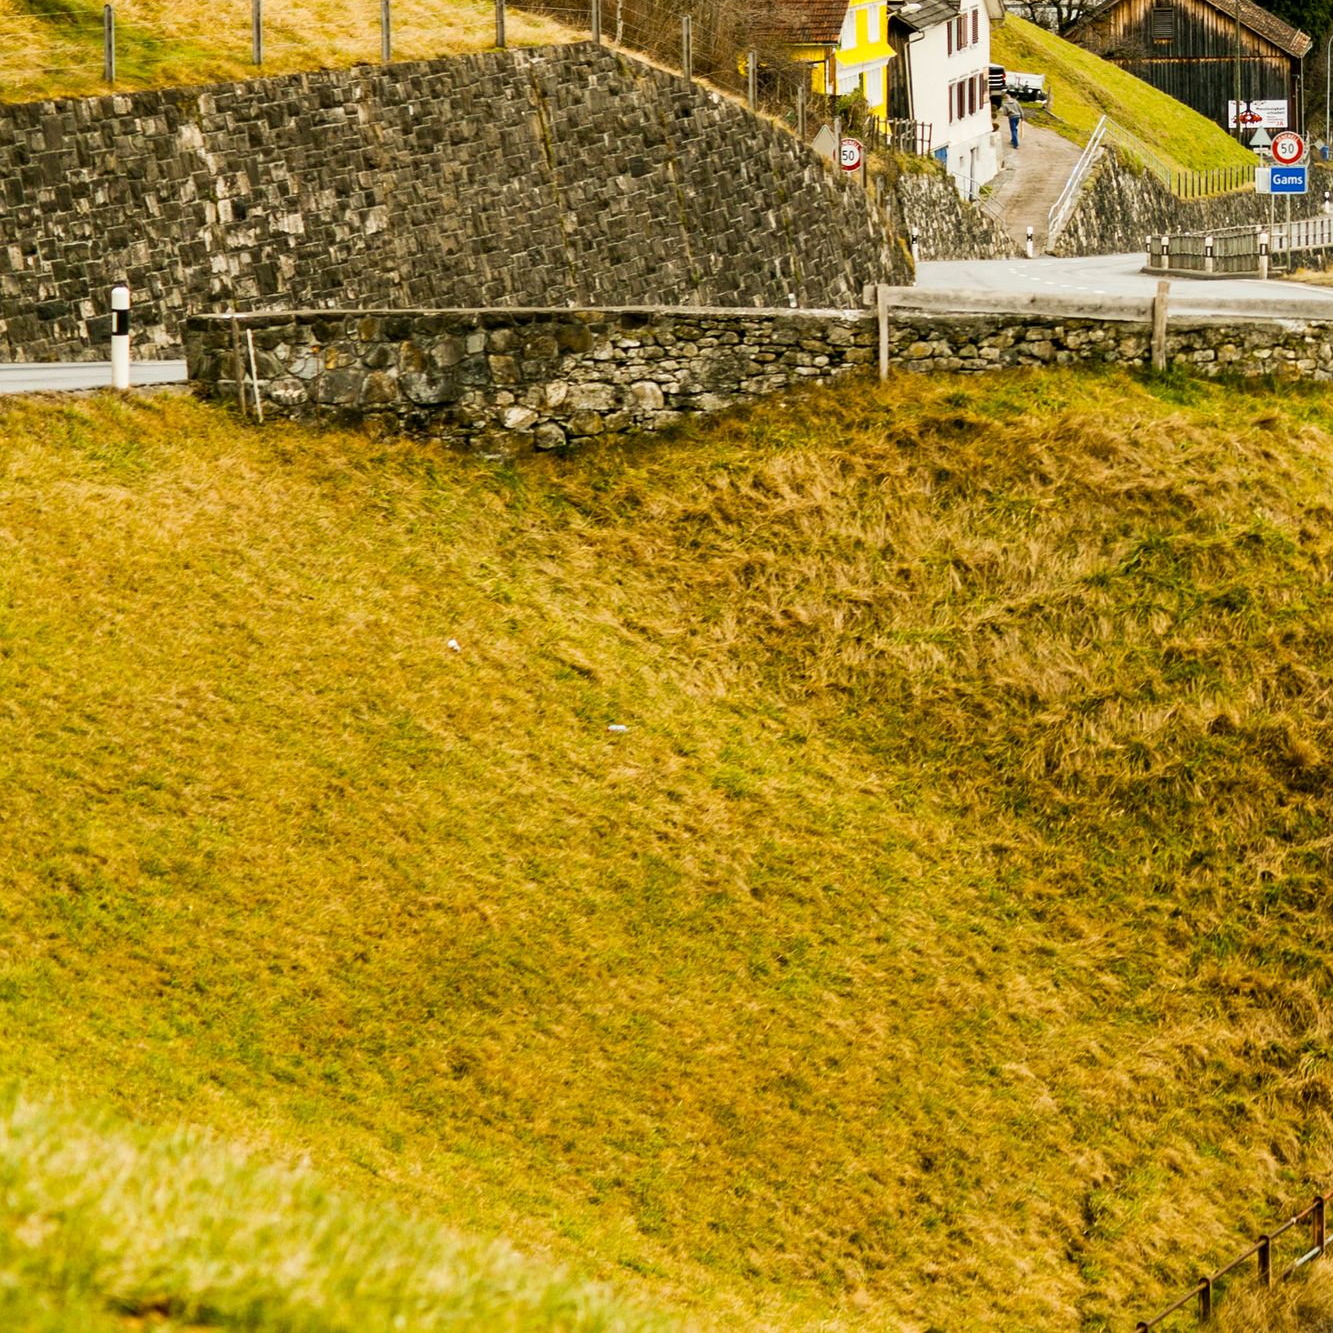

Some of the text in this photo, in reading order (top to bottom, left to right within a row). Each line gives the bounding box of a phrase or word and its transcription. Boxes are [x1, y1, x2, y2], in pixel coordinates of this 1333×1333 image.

[1281, 143, 1294, 154] 50
[842, 150, 854, 161] 50
[1272, 174, 1303, 185] Gams
